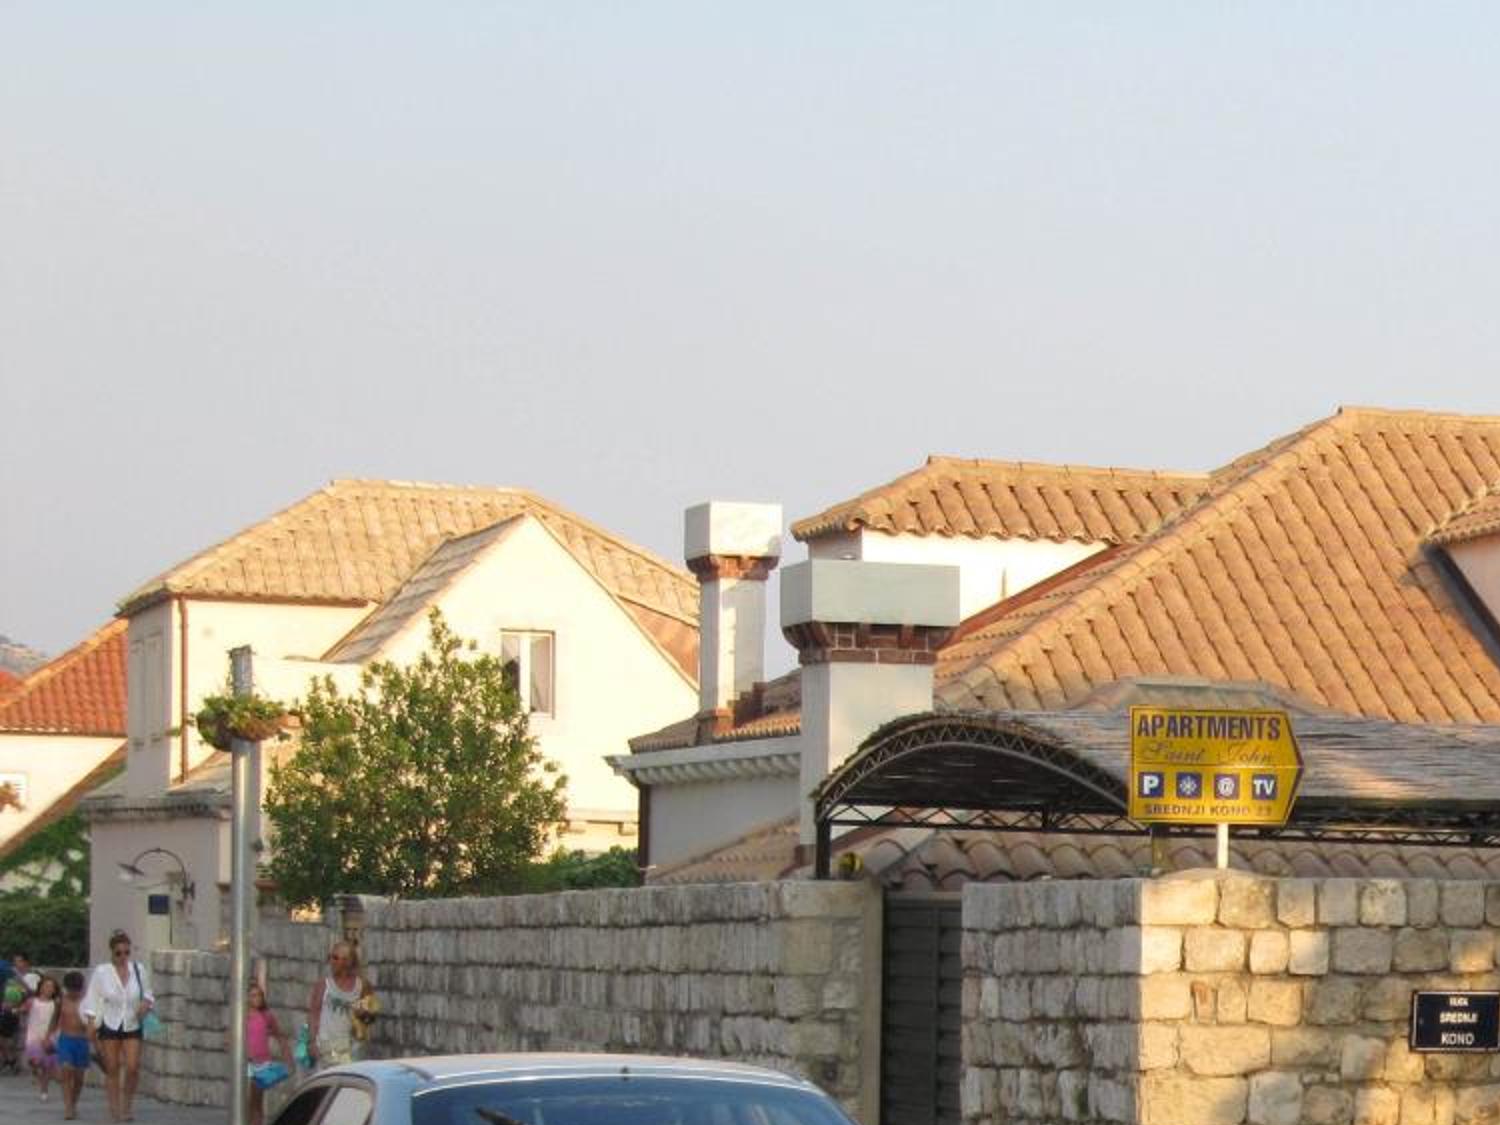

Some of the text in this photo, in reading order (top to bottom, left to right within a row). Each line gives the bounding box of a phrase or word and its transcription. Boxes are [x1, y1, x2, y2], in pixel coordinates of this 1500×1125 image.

[1137, 714, 1281, 741] APARTMENTS
[1143, 775, 1160, 795] P
[1253, 779, 1275, 795] TV
[1441, 1033, 1474, 1045] KONO
